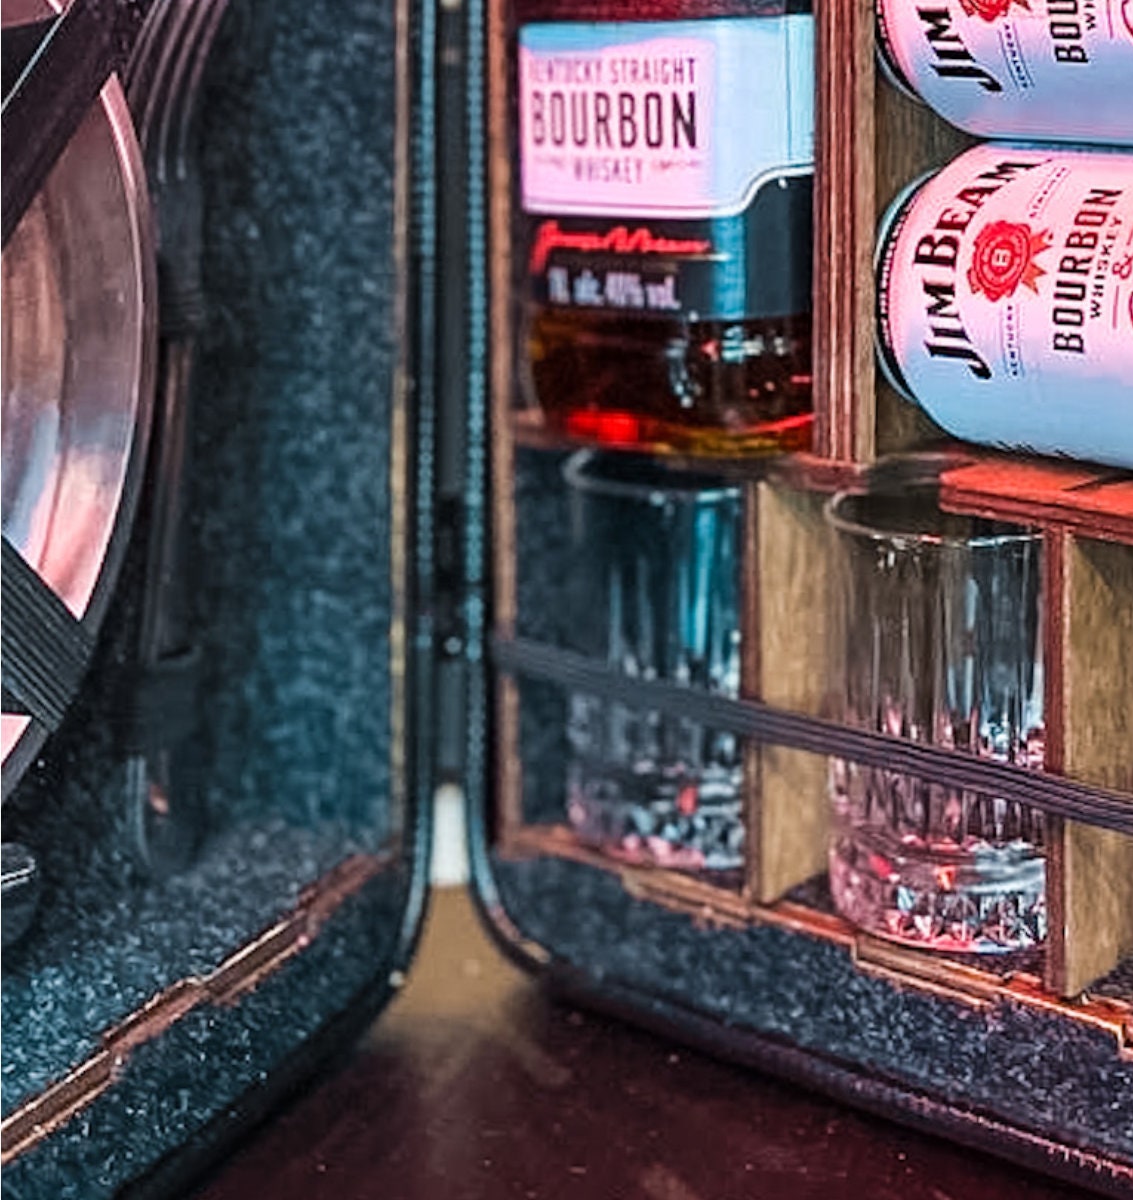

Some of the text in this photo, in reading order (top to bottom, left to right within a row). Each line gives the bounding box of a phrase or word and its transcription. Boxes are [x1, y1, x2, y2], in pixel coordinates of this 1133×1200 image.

[610, 57, 696, 84] STRAIGHT
[915, 5, 1003, 93] JIM
[532, 90, 697, 149] BOURBON
[912, 159, 1052, 381] JIM BEAM
[1051, 187, 1124, 356] BOURBON
[1089, 216, 1125, 319] WHISKEY
[1112, 253, 1133, 280] &
